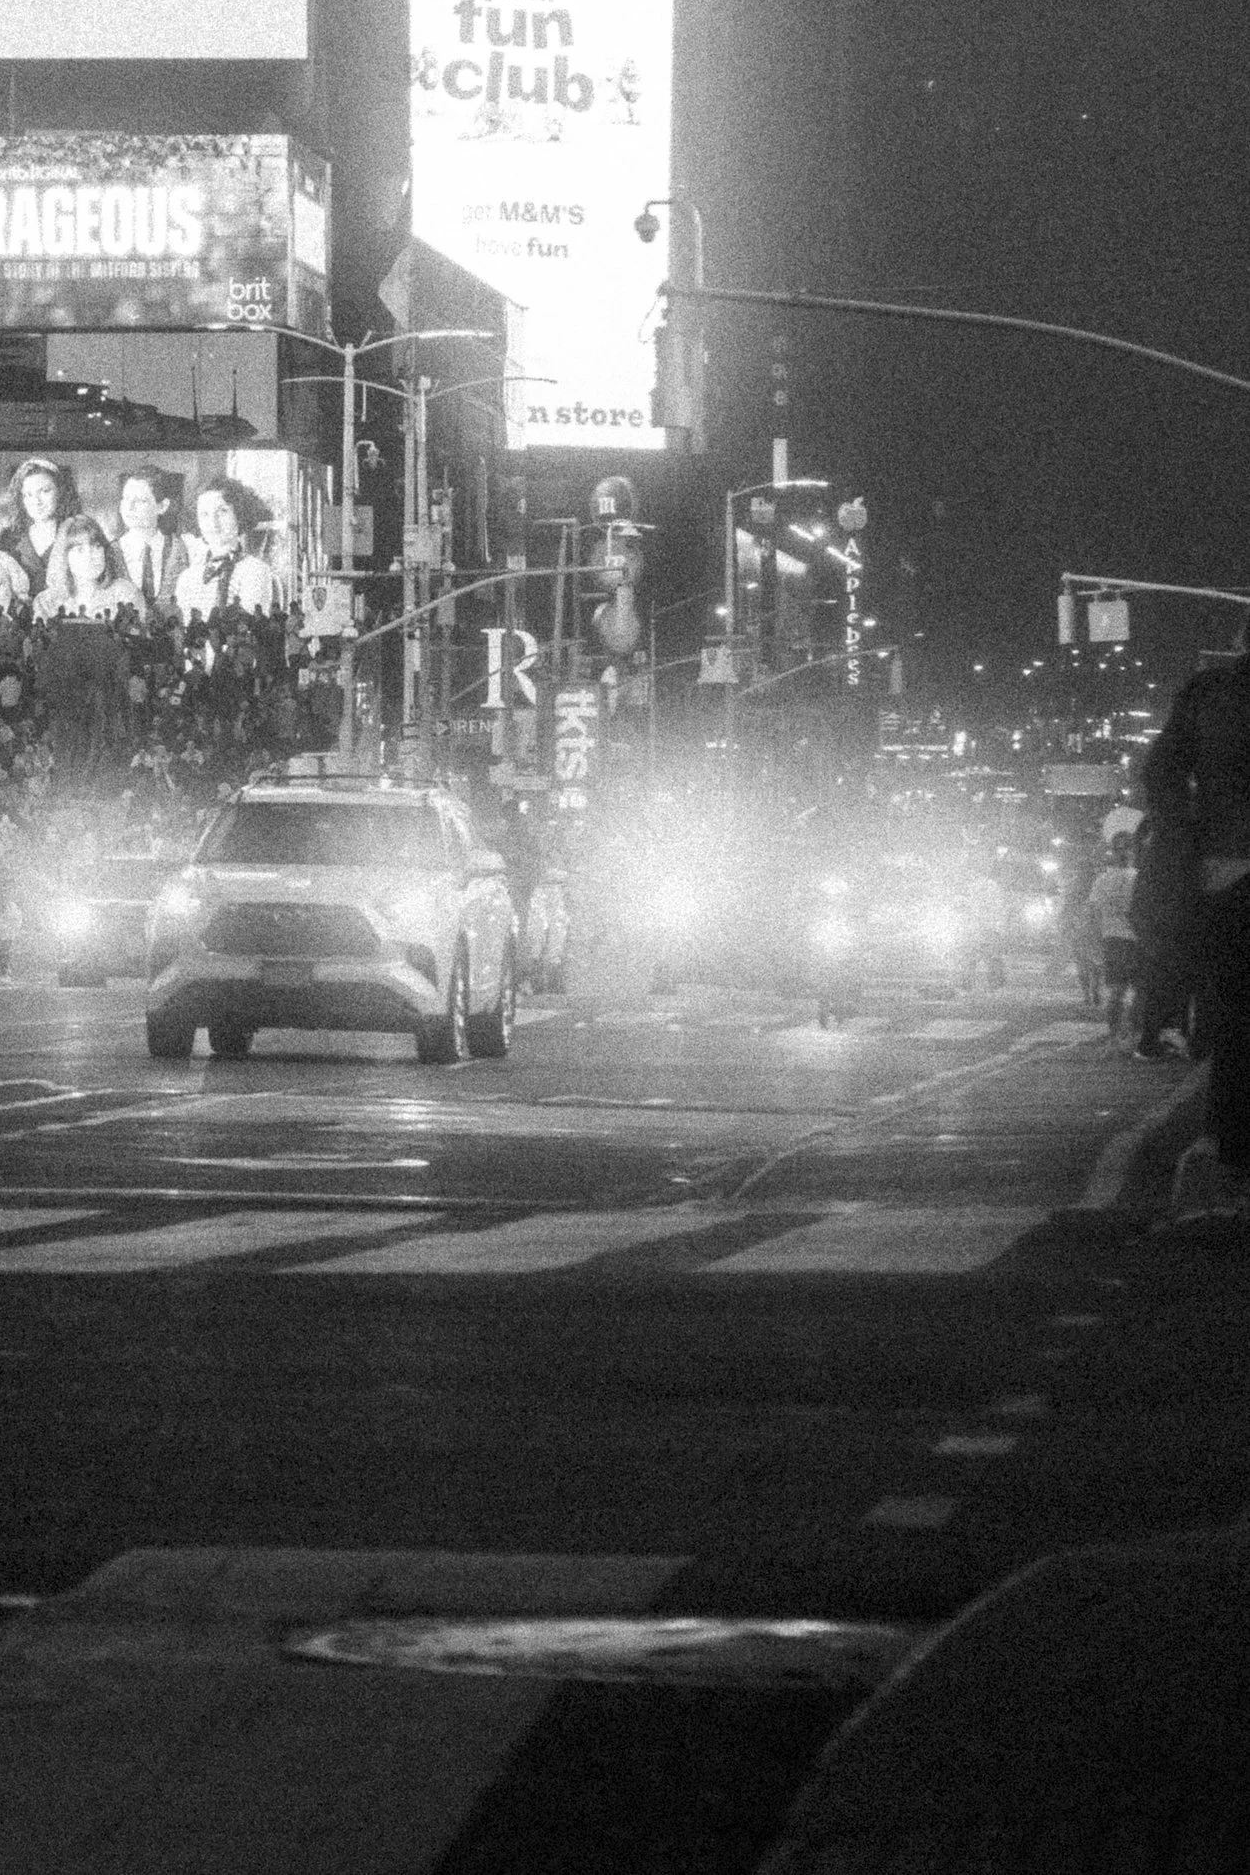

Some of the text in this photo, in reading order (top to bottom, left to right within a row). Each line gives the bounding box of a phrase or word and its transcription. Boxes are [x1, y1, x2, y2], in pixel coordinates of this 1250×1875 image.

[441, 51, 596, 113] club
[526, 237, 569, 258] fun
[229, 276, 271, 302] brit
[227, 299, 273, 321] box
[480, 627, 539, 709] R
